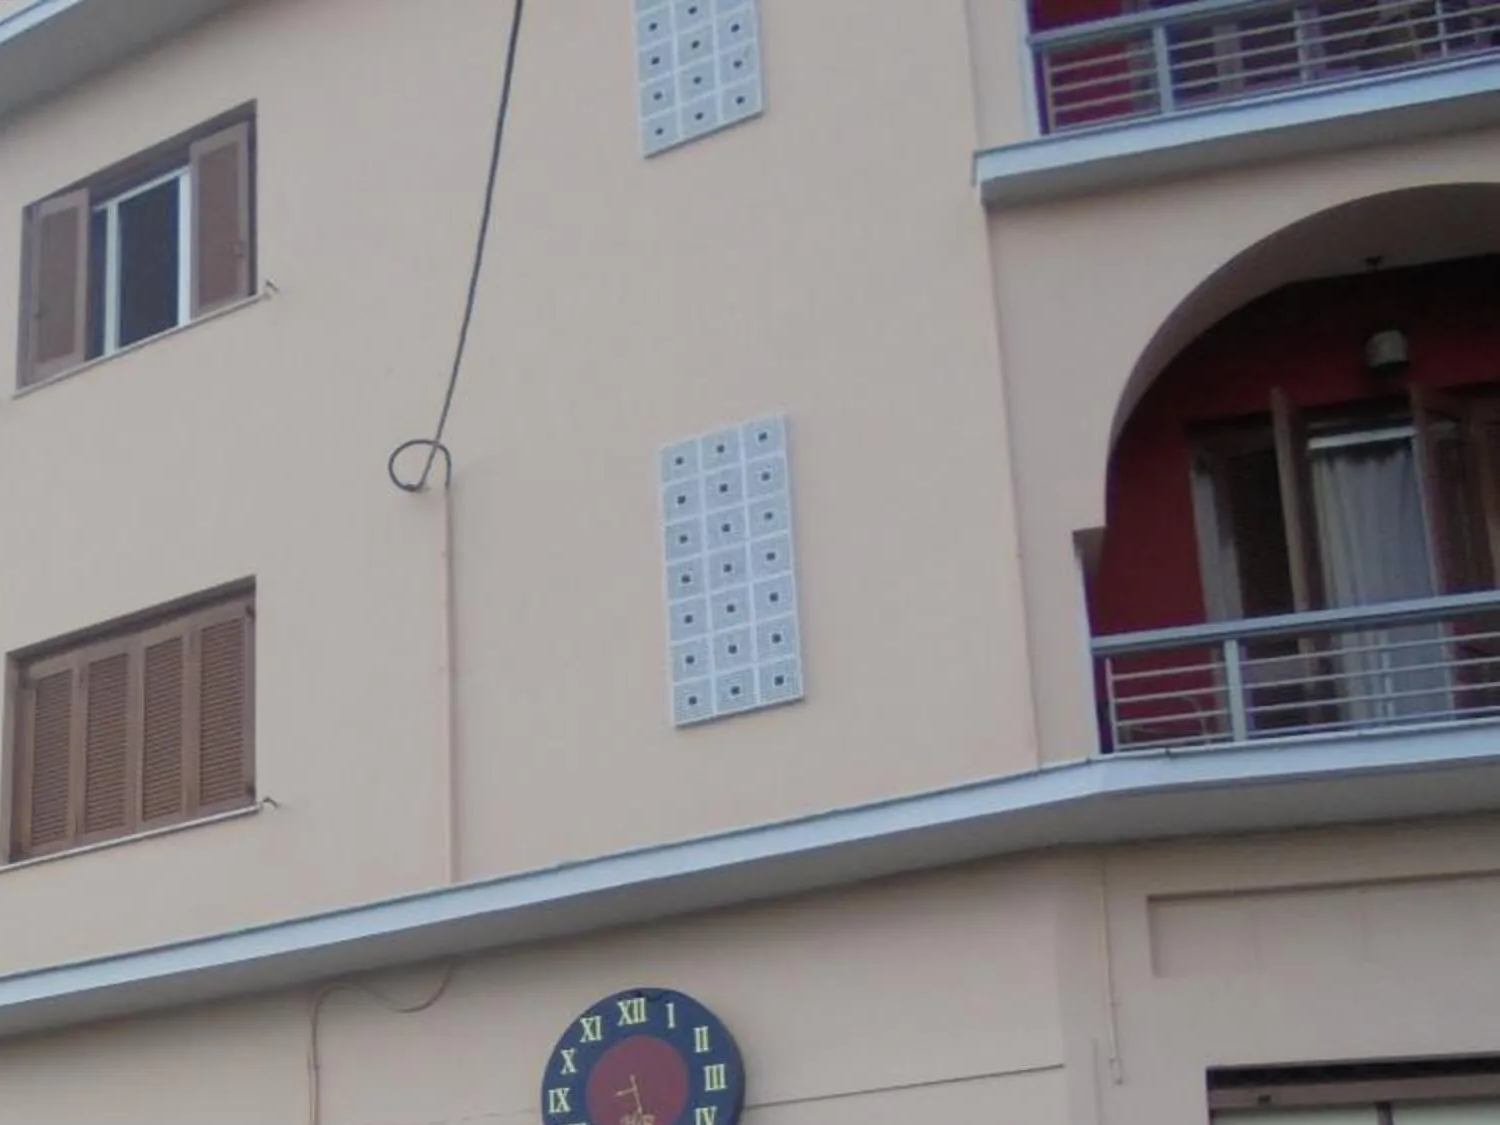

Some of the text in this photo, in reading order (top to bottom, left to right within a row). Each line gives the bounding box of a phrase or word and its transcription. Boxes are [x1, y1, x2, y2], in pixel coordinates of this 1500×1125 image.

[618, 998, 647, 1026] XII
[666, 1003, 675, 1028] I
[580, 1016, 602, 1042] XI
[694, 1026, 709, 1052] II
[560, 1048, 576, 1074] X
[704, 1064, 726, 1091] III
[548, 1087, 570, 1113] IX
